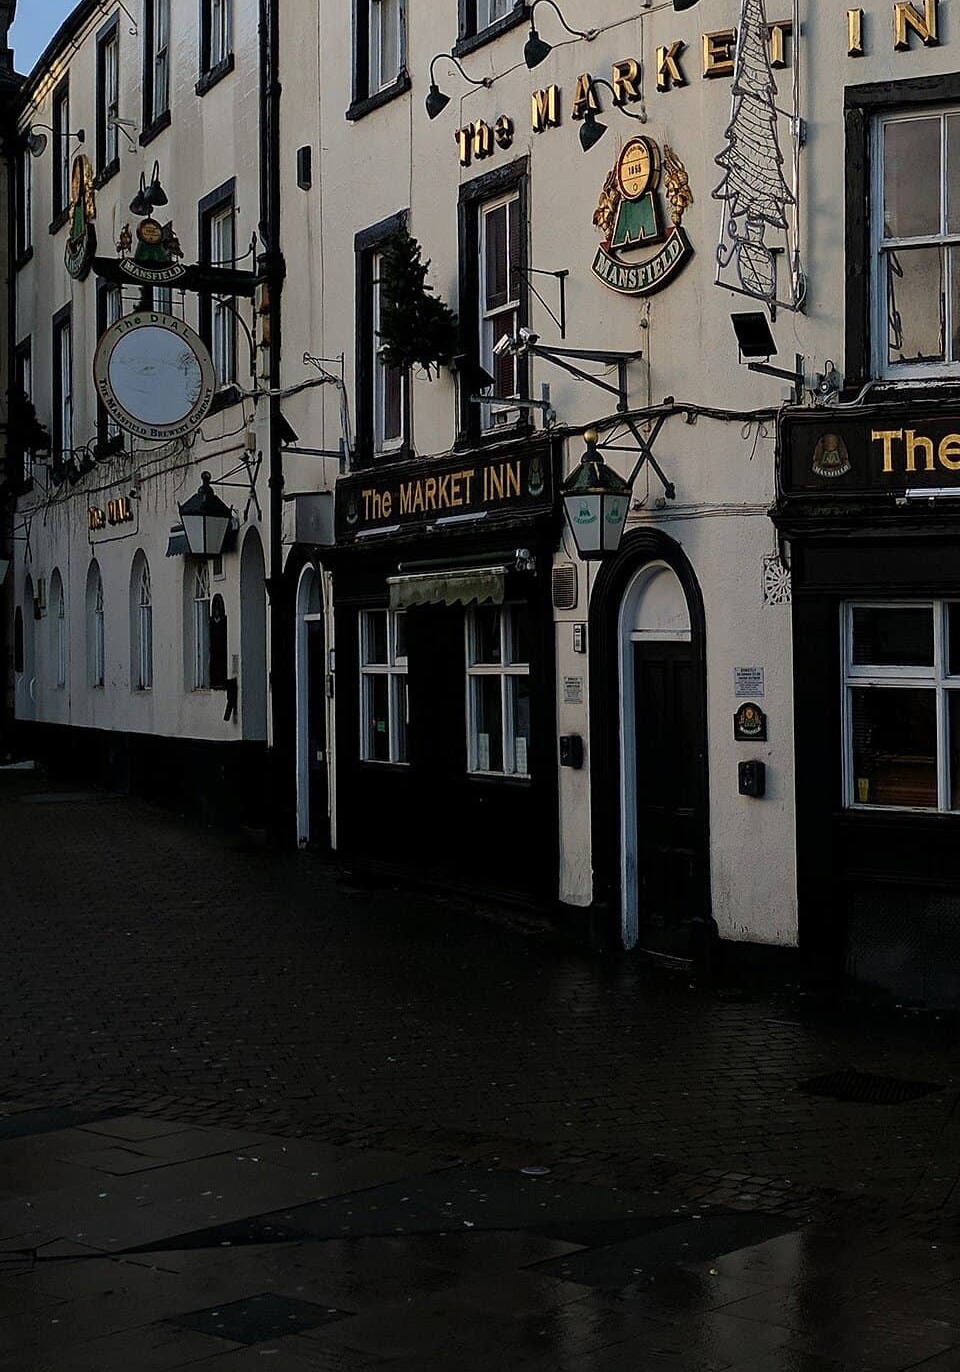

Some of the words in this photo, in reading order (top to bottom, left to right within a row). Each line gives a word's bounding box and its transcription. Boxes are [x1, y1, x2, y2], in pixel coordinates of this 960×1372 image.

[455, 115, 514, 167] The
[531, 19, 794, 134] MARKET
[123, 260, 182, 281] MANSFIELD
[594, 239, 681, 289] MANSFIELD
[115, 316, 142, 334] The
[150, 313, 191, 340] DIAL
[361, 489, 393, 522] The
[399, 469, 475, 517] MARKET
[482, 460, 522, 502] INN
